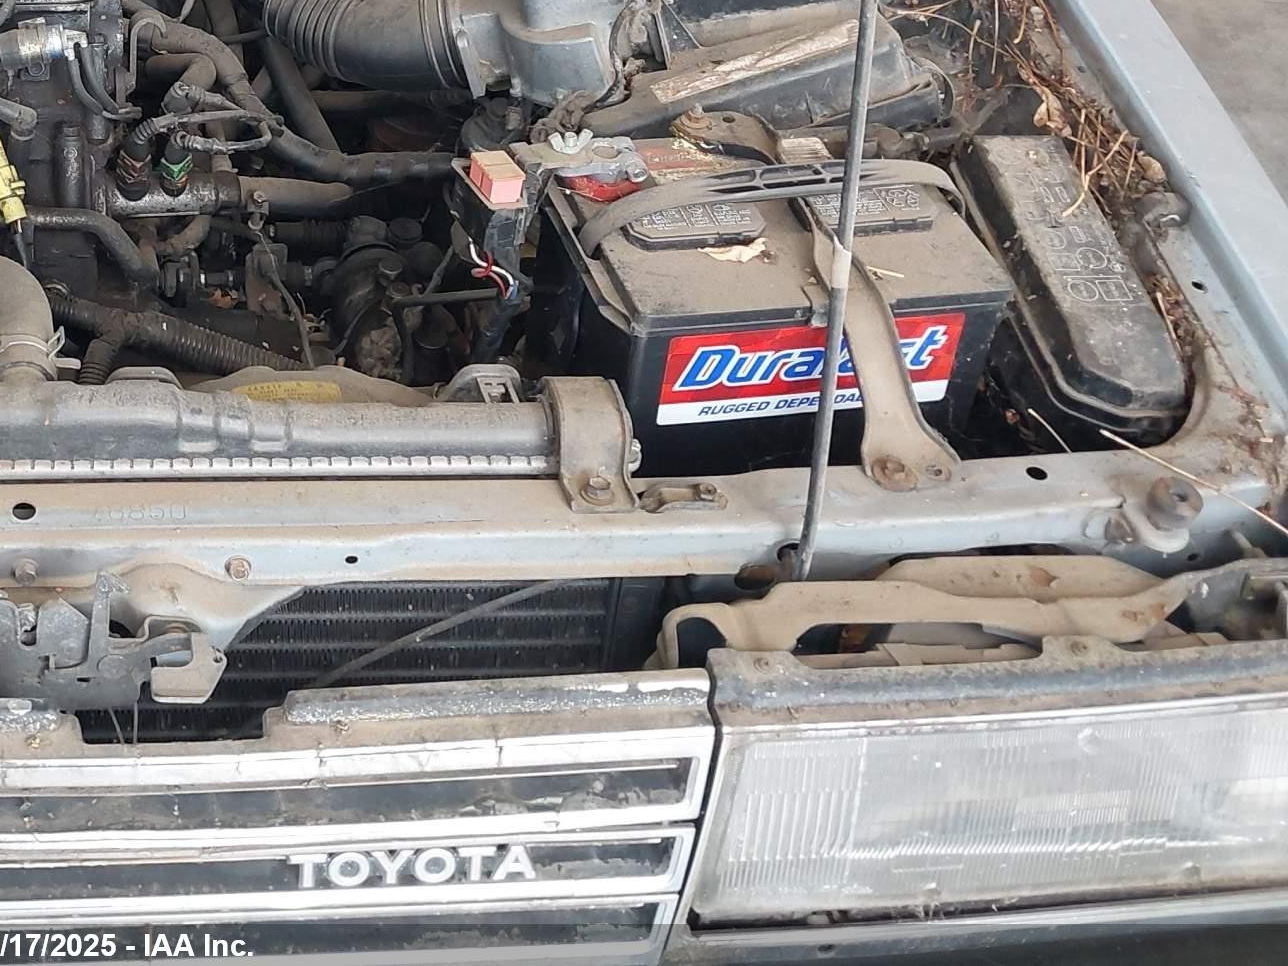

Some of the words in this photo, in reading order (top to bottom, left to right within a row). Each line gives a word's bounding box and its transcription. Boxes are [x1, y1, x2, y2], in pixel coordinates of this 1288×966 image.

[672, 324, 949, 392] Durat
[697, 400, 771, 417] RUGGED
[288, 843, 537, 888] TOYOTA
